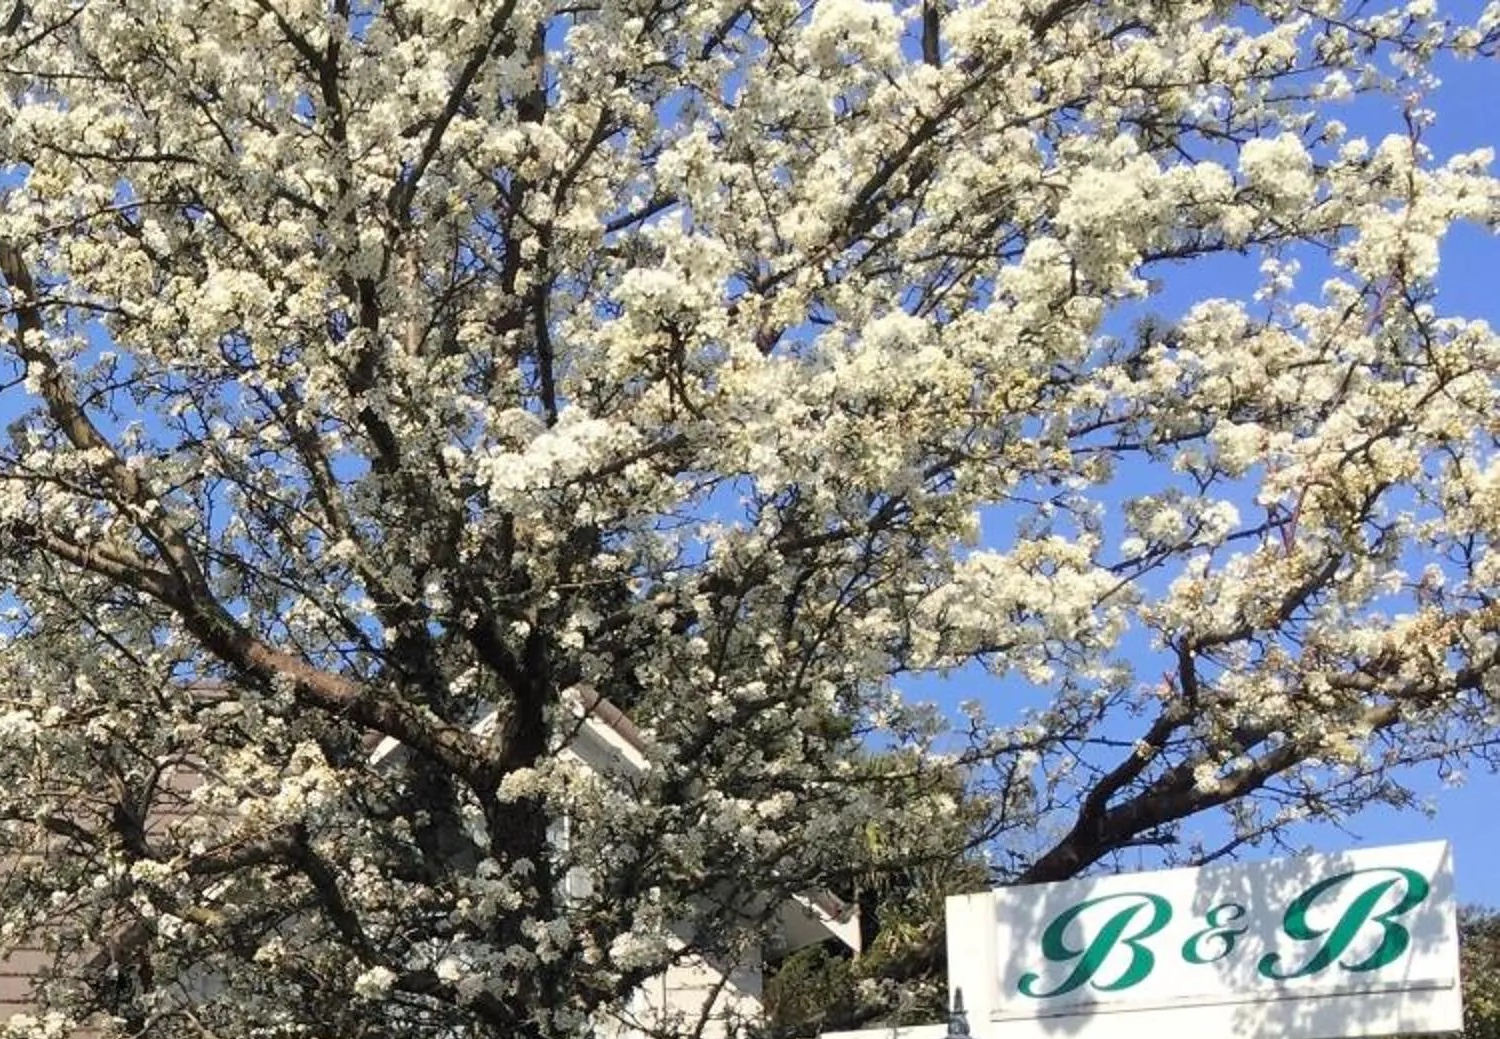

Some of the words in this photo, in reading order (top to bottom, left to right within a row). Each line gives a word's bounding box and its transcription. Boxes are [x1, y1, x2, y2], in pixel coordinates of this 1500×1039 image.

[1018, 892, 1173, 998] B
[1181, 903, 1250, 964] &
[1257, 866, 1430, 980] B
